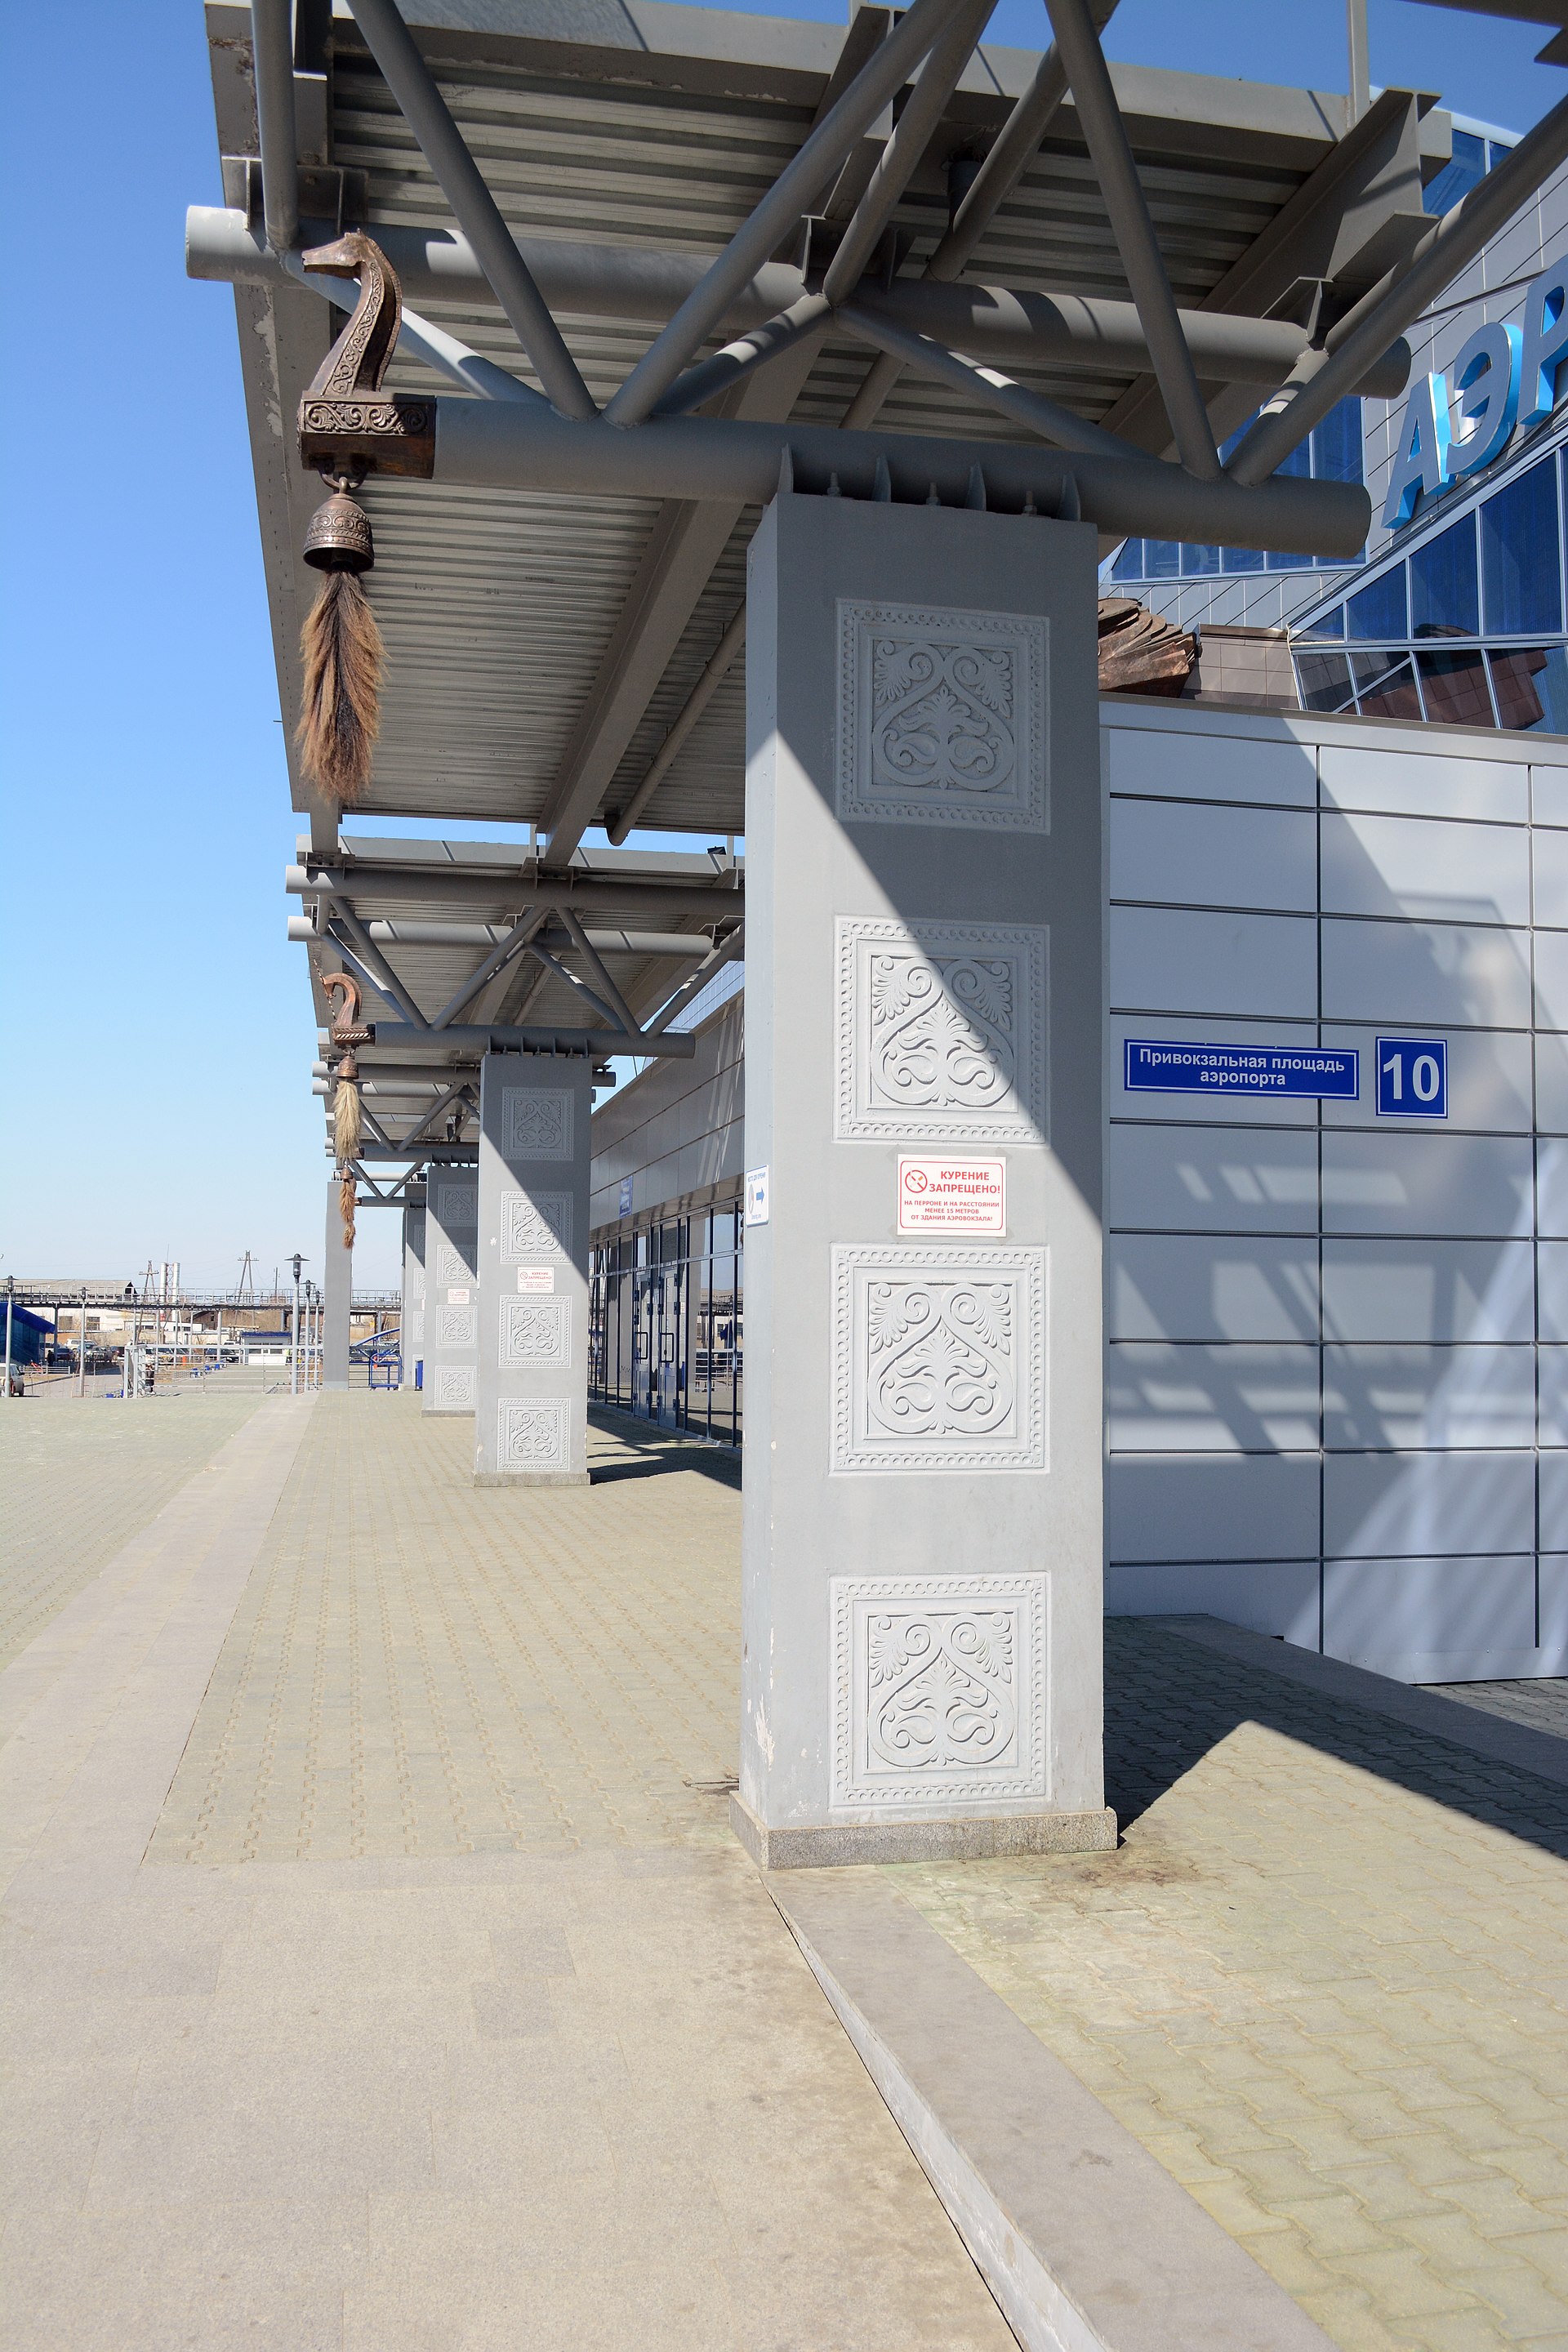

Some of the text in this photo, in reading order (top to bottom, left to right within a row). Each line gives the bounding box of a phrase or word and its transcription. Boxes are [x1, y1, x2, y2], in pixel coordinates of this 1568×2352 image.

[1139, 1048, 1345, 1073] Привокзальная площадь
[1200, 1069, 1286, 1088] аэропорта
[1382, 1053, 1441, 1102] 10
[940, 1170, 990, 1181] КУРЕНИЕ
[929, 1183, 1000, 1195] ЗАПРЕЩЕНО!
